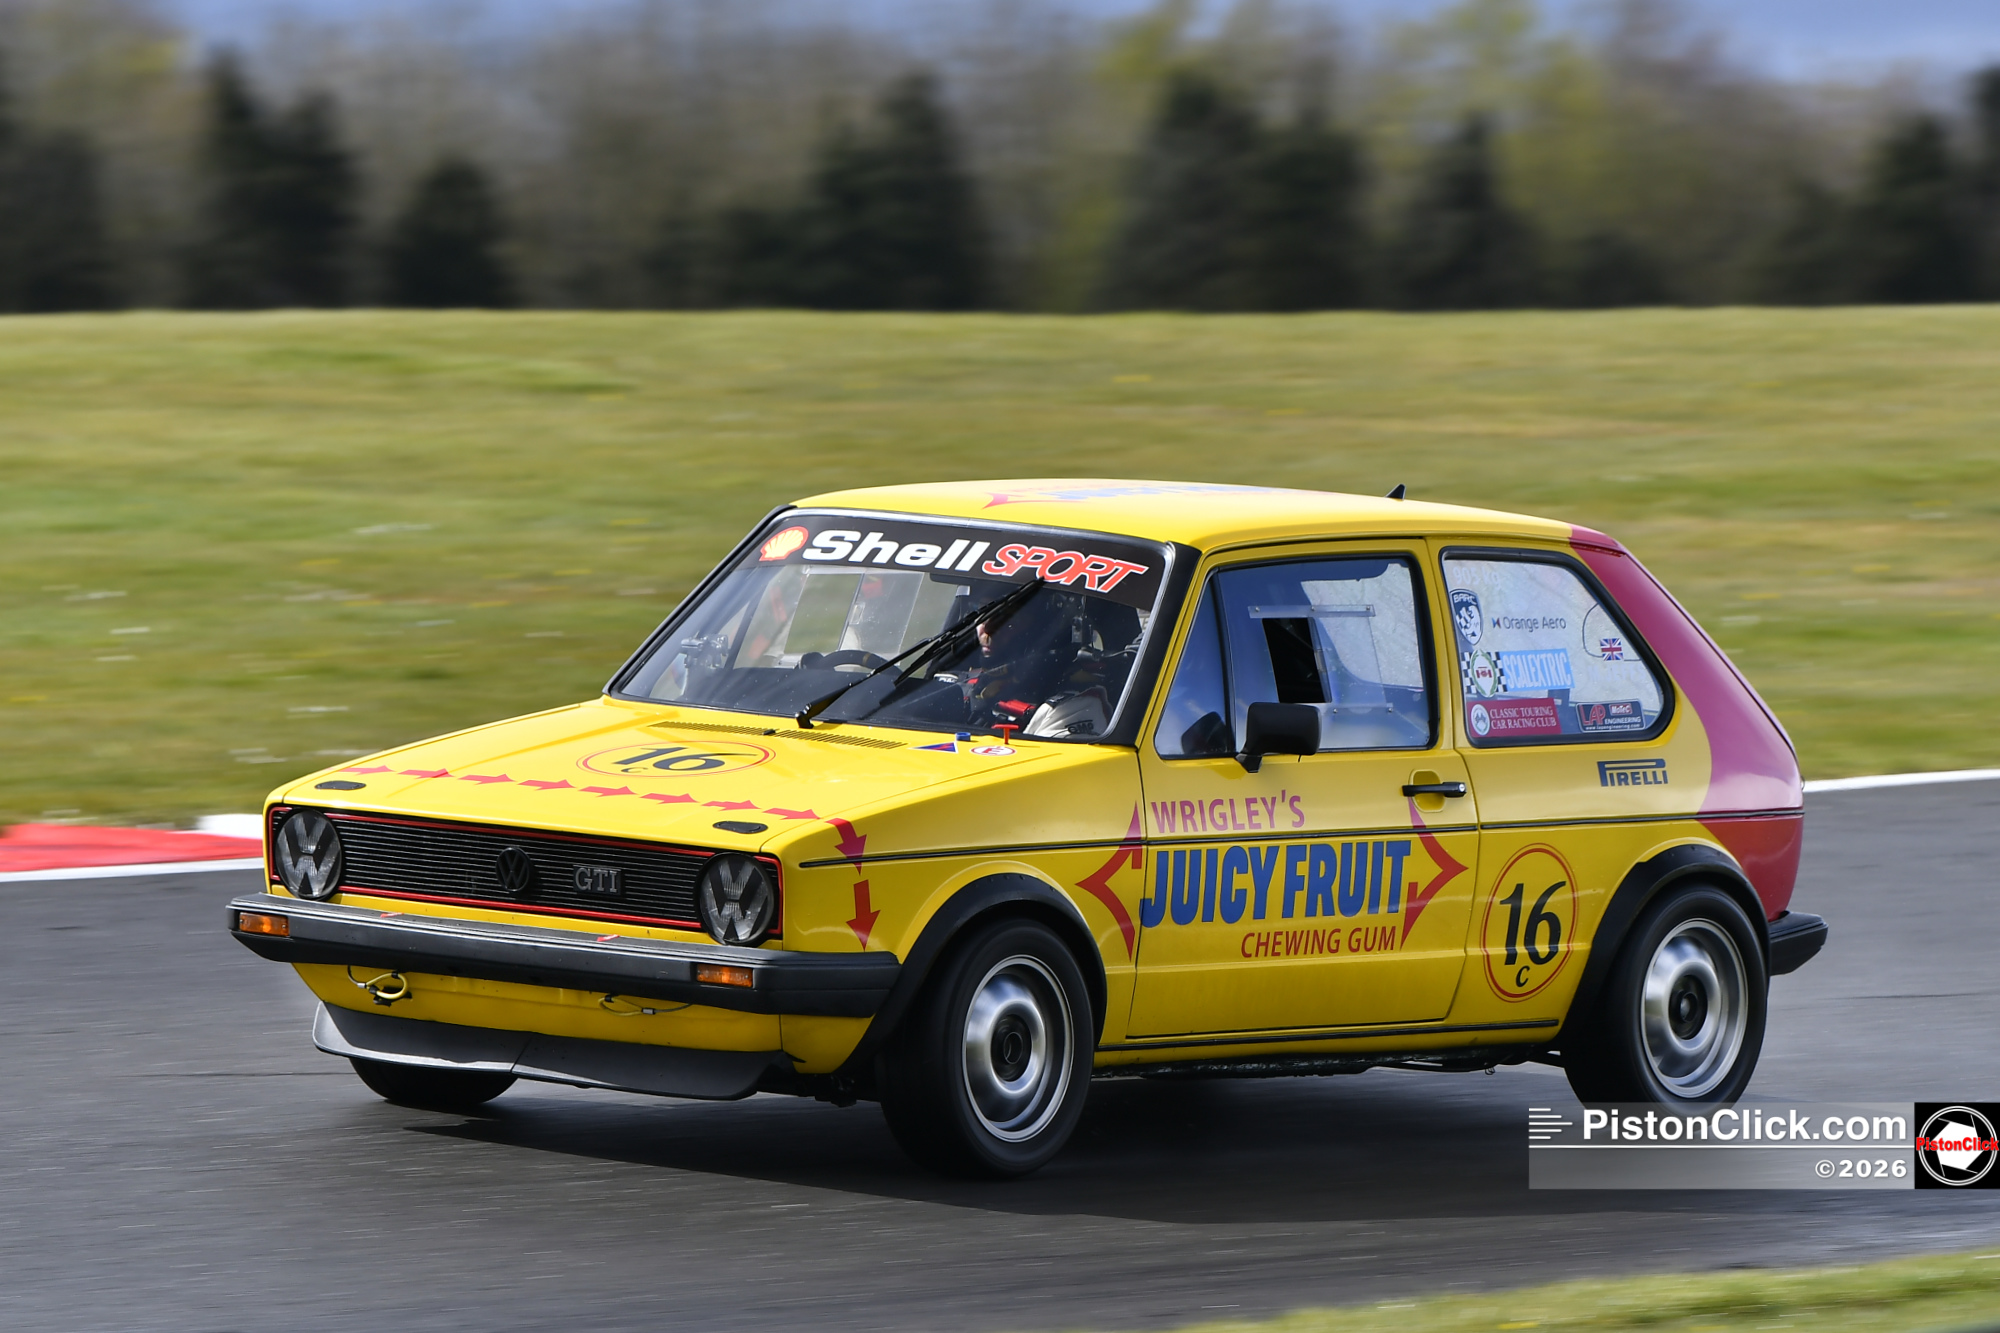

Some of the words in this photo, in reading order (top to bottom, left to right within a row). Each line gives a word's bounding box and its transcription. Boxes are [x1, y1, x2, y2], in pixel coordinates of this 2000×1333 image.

[802, 529, 990, 571] Shell
[982, 543, 1150, 593] SPORT
[1453, 593, 1477, 605] BARC
[1503, 617, 1539, 633] Orange
[1542, 617, 1567, 629] Aero
[1502, 652, 1572, 689] SCALEXTRIC
[1490, 708, 1519, 719] CLASSIC
[1520, 706, 1553, 717] TOURING
[1491, 720, 1507, 730] CAR
[1508, 718, 1535, 729] RACING
[1536, 717, 1557, 727] CLUB
[1579, 704, 1606, 725] LAP
[1604, 716, 1642, 725] ENGINEERING
[611, 746, 758, 771] 16
[1597, 758, 1669, 787] PIRELLI
[1151, 789, 1306, 834] WRIGLEY'S
[574, 866, 621, 894] GTI
[1139, 844, 1280, 929] JUICY
[1281, 839, 1412, 919] FRUIT
[1499, 880, 1567, 966] 16
[1241, 927, 1342, 958] CHEWING
[1347, 925, 1397, 954] GUM
